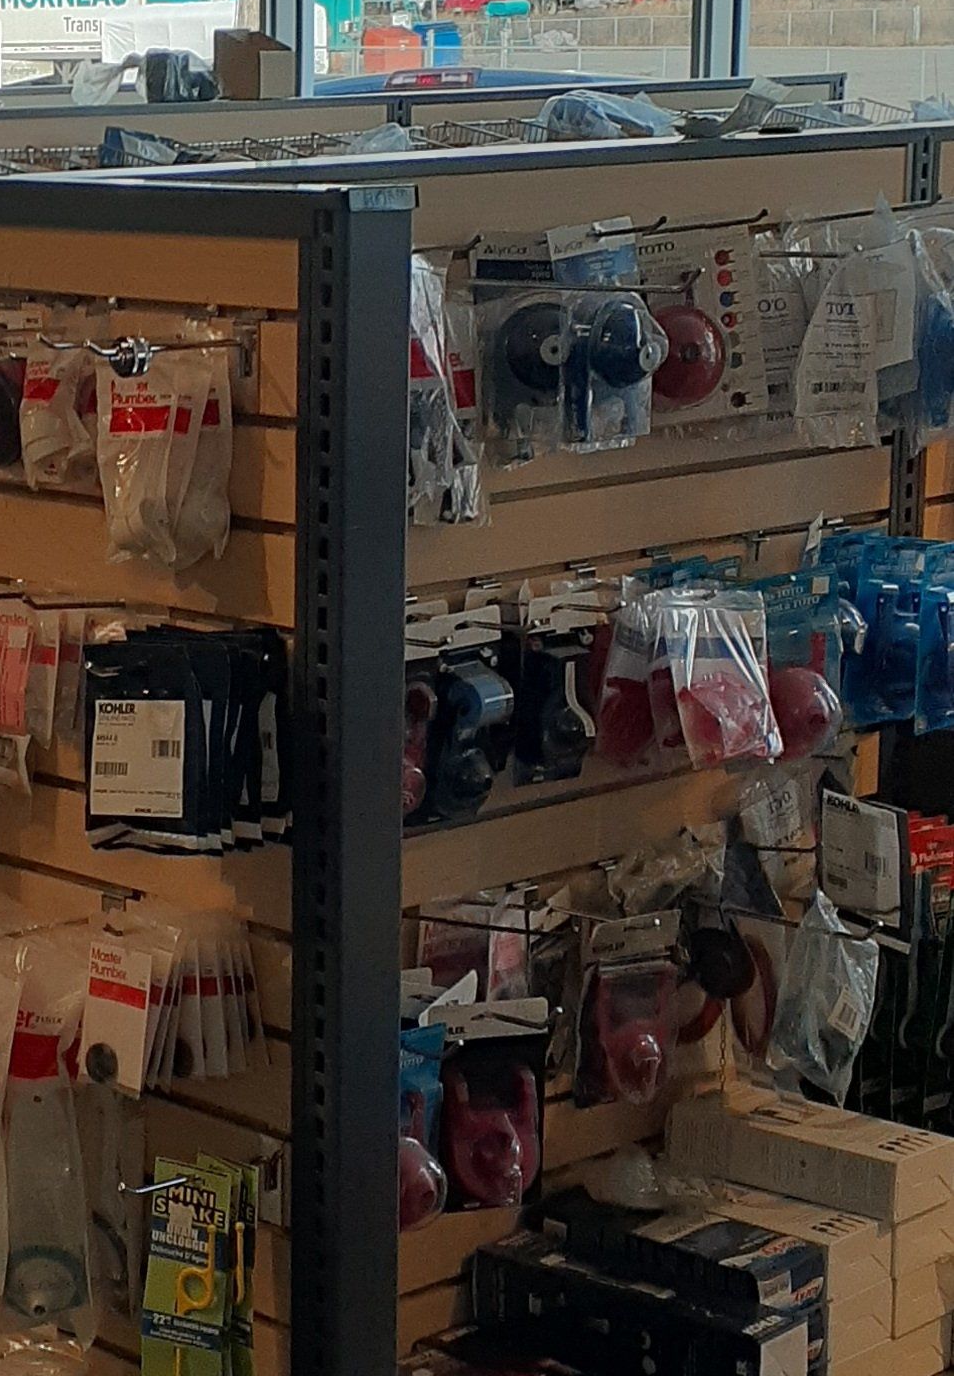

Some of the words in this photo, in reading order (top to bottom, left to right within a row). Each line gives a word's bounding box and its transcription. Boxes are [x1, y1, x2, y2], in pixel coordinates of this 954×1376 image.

[639, 242, 675, 256] TOTO
[99, 703, 136, 714] KOHLER
[92, 947, 122, 965] Master
[90, 962, 127, 980] Plumber
[167, 1184, 215, 1209] MINI
[154, 1195, 226, 1228] SKE
[151, 1230, 209, 1254] UNCLOGGE
